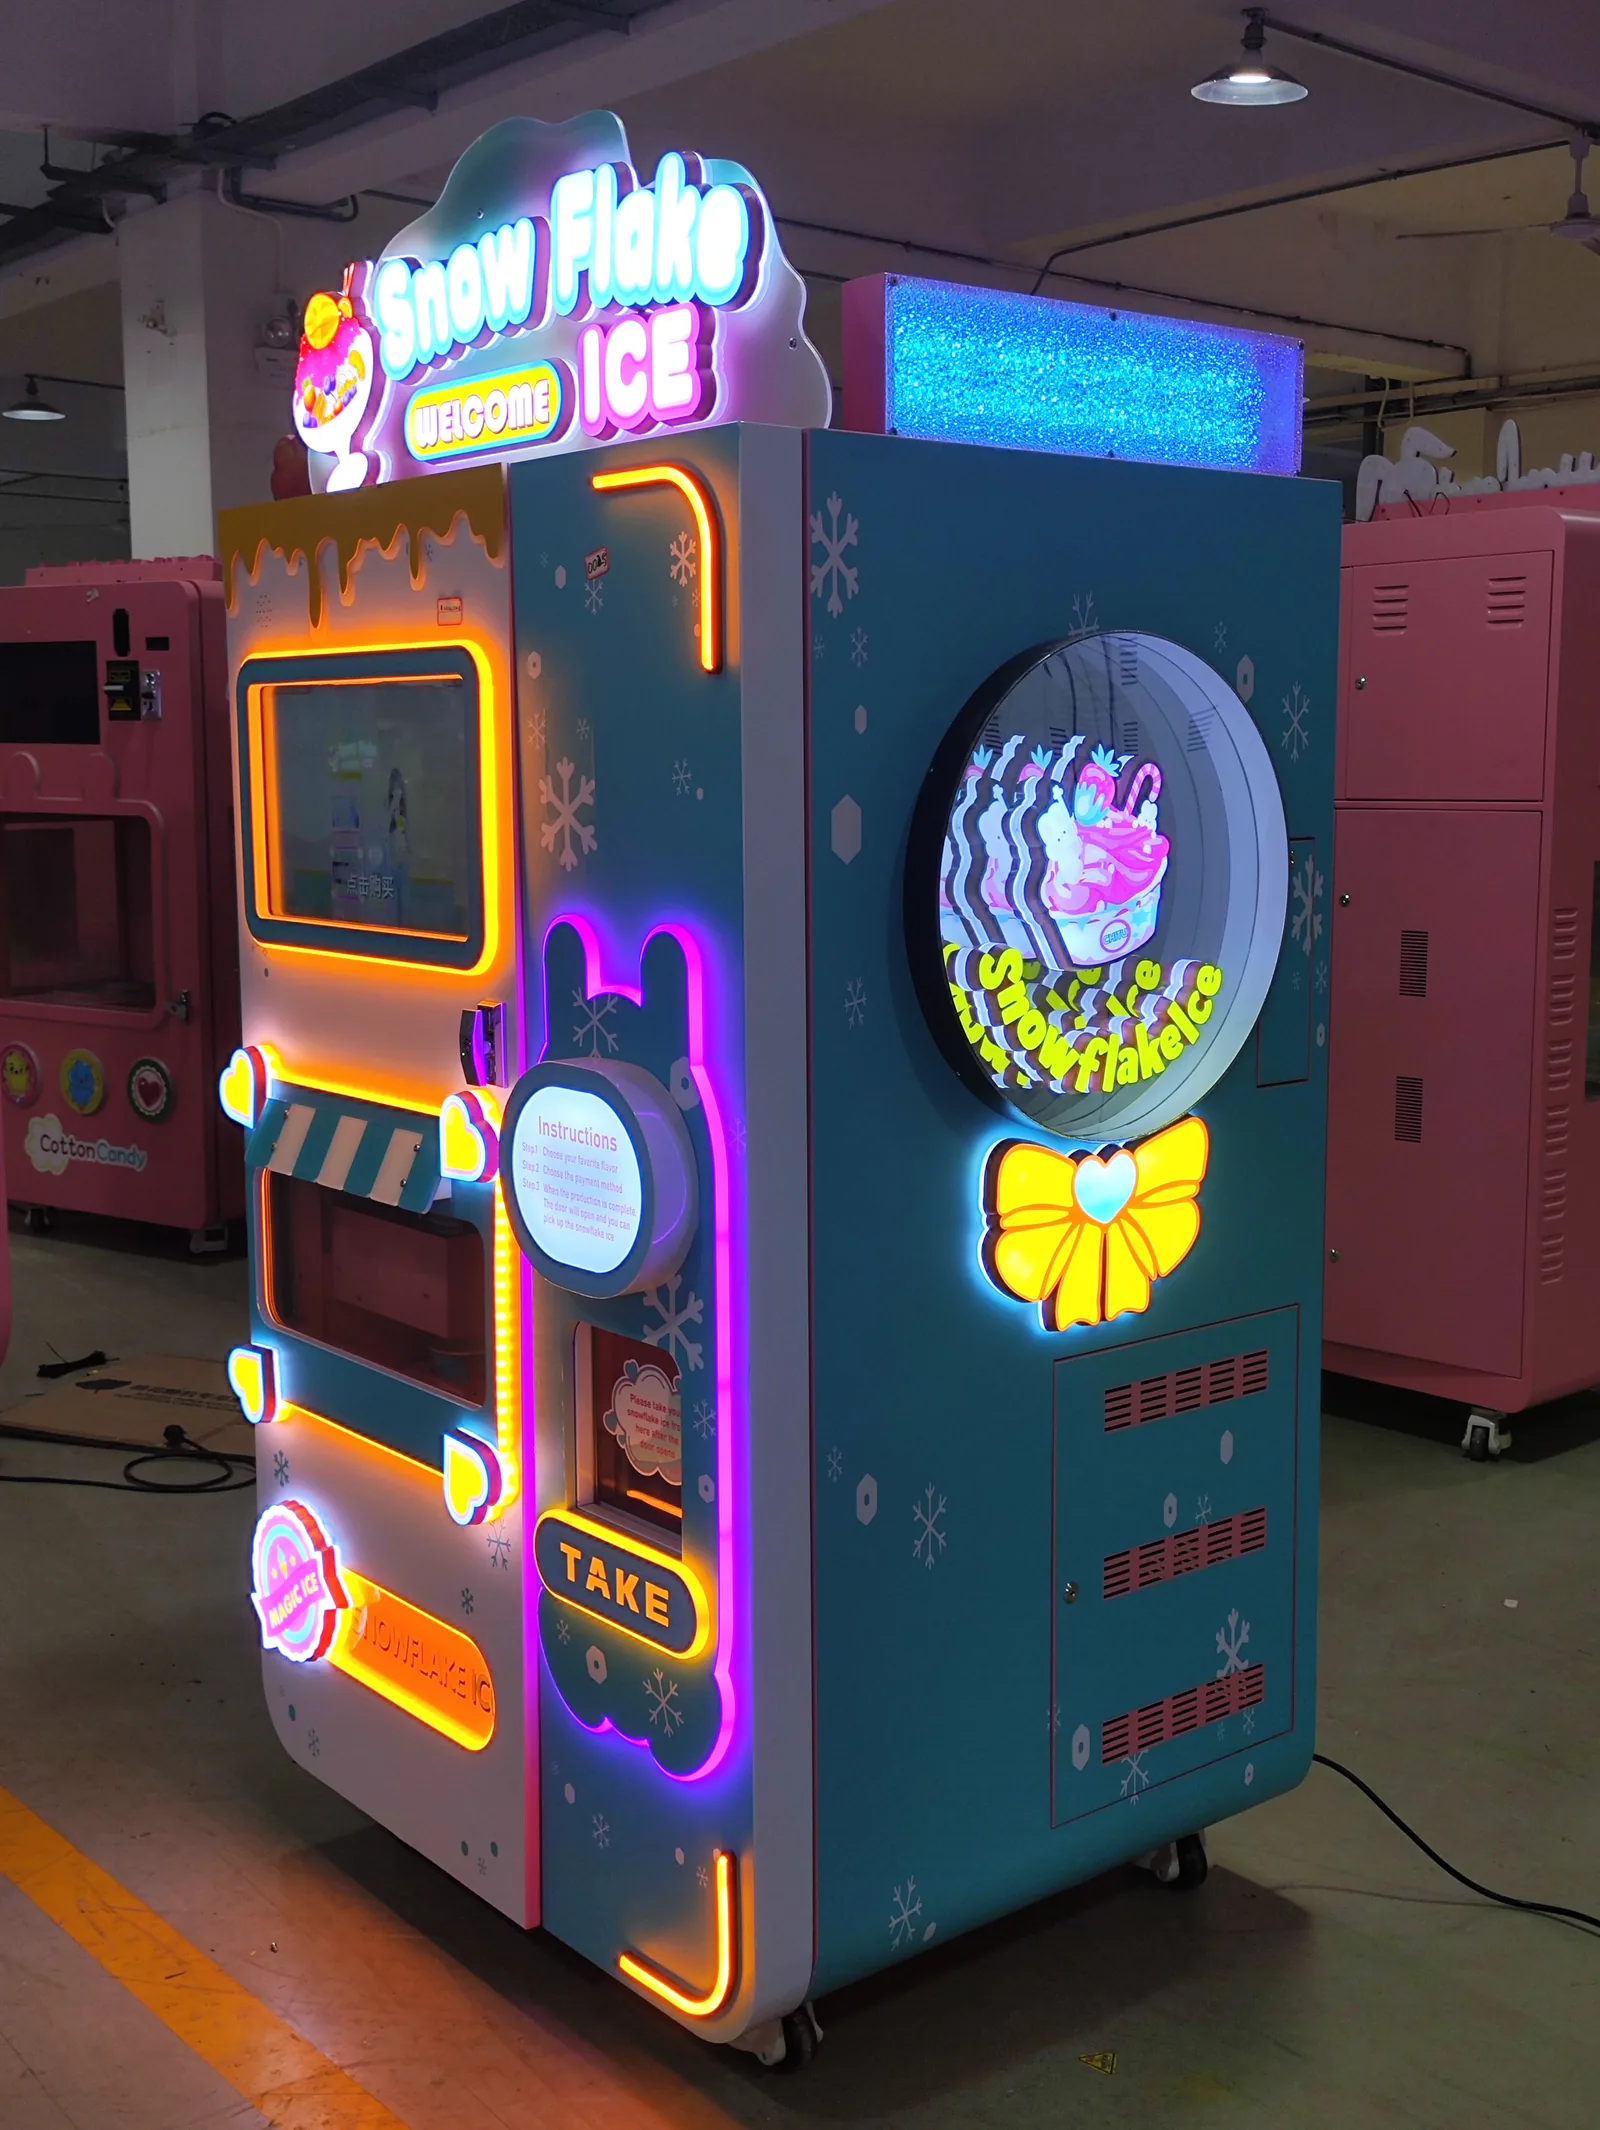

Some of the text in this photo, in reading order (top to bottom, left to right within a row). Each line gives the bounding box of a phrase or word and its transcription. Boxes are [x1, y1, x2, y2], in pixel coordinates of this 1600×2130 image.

[375, 151, 752, 381] Snow Flake
[577, 301, 701, 437] ICE
[415, 379, 551, 449] WELCOME
[347, 874, 395, 899] 点击购买
[538, 1115, 618, 1152] Instructions
[542, 1146, 563, 1161] Choose
[564, 1154, 577, 1163] your
[578, 1155, 600, 1170] favorite
[601, 1160, 618, 1173] flavor
[542, 1165, 563, 1179] Choose
[564, 1170, 574, 1181] the
[575, 1174, 600, 1188] payment
[600, 1180, 623, 1194] method
[543, 1183, 559, 1196] When
[560, 1187, 569, 1199] the
[570, 1191, 601, 1207] production
[601, 1199, 608, 1209] is
[543, 1198, 631, 1230] The door will open and you can
[543, 1214, 615, 1242] pick up the snowflake ice
[627, 1408, 681, 1432] snowflake ice fro
[630, 1393, 680, 1418] Please take you
[635, 1423, 679, 1445] here after the
[640, 1439, 676, 1459] door opens
[559, 1542, 670, 1628] TAKE
[269, 1571, 319, 1629] MAGIC ICE
[471, 1668, 495, 1716] IC
